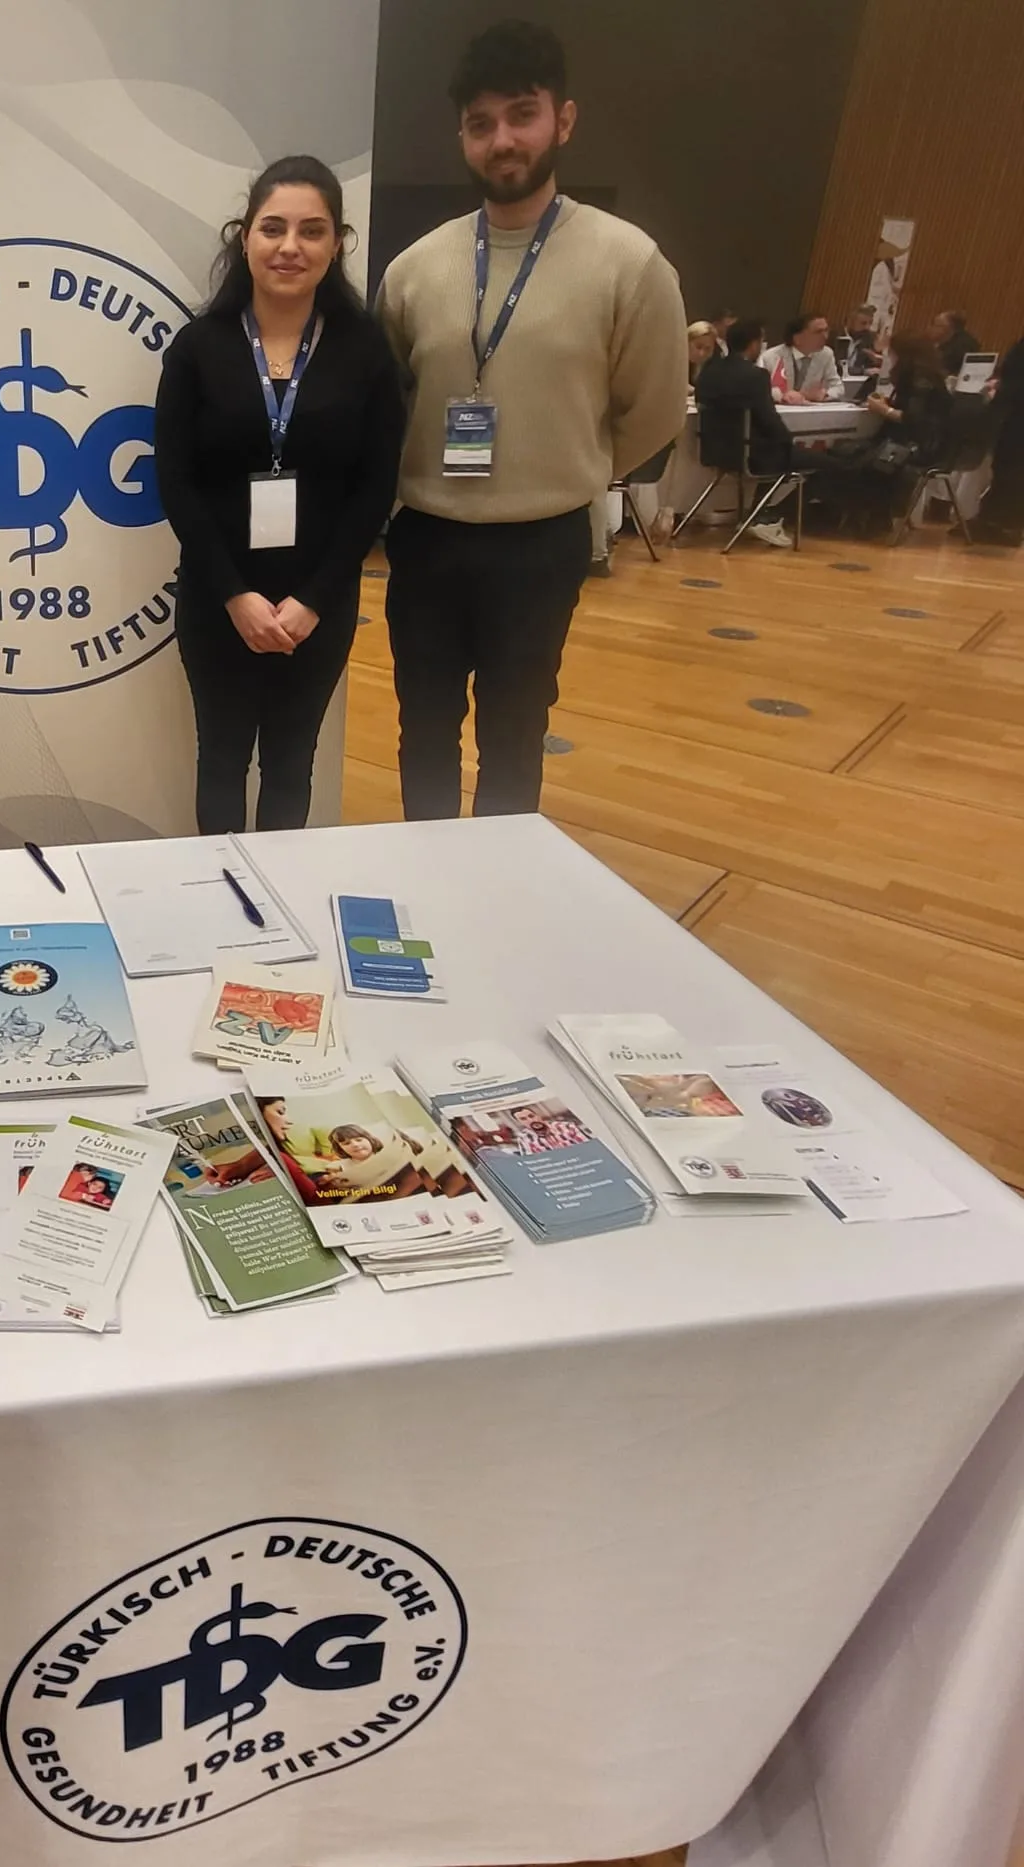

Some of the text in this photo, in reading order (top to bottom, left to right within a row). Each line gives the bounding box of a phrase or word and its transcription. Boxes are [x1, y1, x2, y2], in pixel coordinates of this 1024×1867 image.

[49, 267, 173, 354] DEUTS
[71, 567, 181, 669] TIFTU
[14, 1138, 46, 1149] früh
[80, 1135, 147, 1159] frühstart
[32, 1556, 213, 1700] TÜRKISCH
[263, 1534, 438, 1622] DEUTSCHE
[76, 1613, 389, 1753] TDG
[21, 1637, 447, 1830] GESUNDHEIT TIFTUNG e.V.
[184, 1730, 286, 1785] 1988
